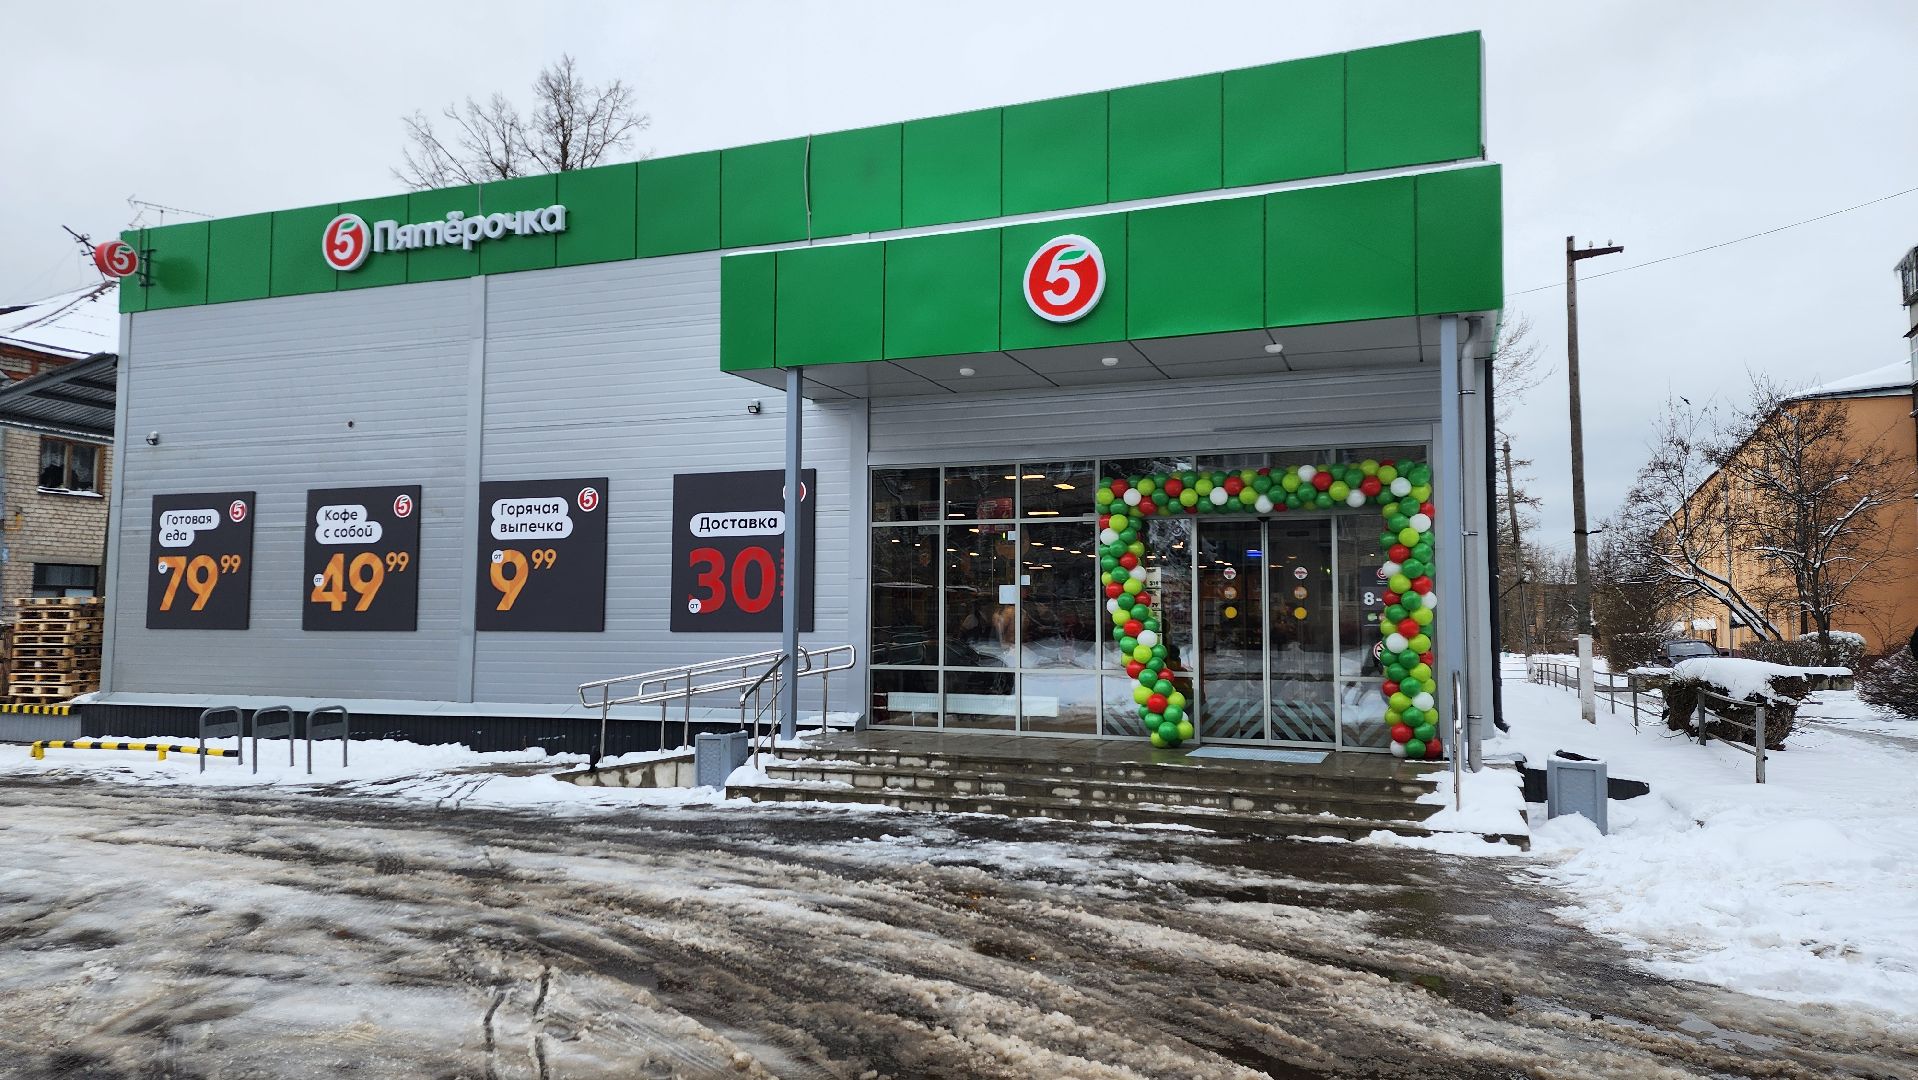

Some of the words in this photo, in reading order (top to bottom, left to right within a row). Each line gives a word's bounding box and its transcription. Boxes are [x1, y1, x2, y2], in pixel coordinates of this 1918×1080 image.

[373, 204, 567, 253] Пятёрочка
[1042, 245, 1089, 306] 5
[324, 508, 359, 523] Кофе
[500, 503, 560, 517] Горячая
[166, 513, 212, 526] Готовая
[500, 520, 564, 533] выпечка
[699, 516, 778, 532] Доставка
[165, 530, 188, 542] еда
[323, 529, 330, 538] с
[334, 524, 373, 538] собой
[158, 554, 219, 611] 79
[220, 554, 242, 574] 99
[310, 551, 385, 612] 49
[385, 551, 410, 572] 99
[490, 549, 529, 611] 9
[531, 548, 557, 570] 99
[688, 546, 776, 614] 30
